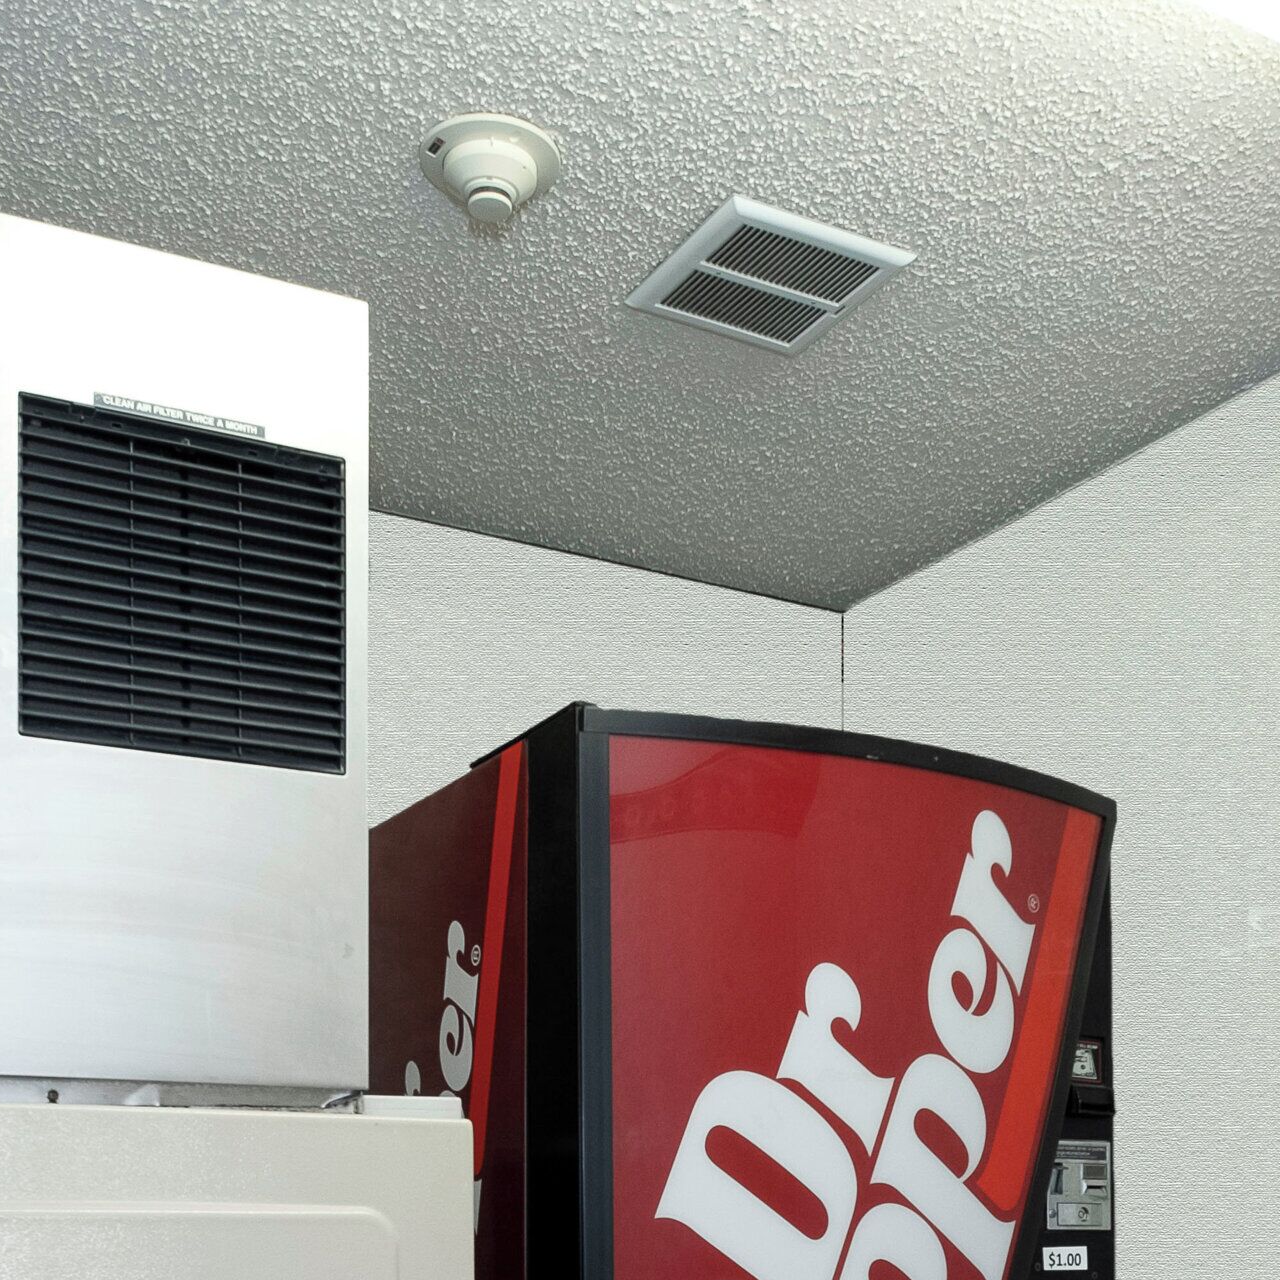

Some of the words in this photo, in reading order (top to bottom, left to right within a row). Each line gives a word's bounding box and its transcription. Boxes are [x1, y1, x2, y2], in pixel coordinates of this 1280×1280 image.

[103, 395, 135, 410] CLEAN
[136, 402, 152, 413] AIR
[153, 405, 183, 420] FILTER
[185, 411, 215, 427] TWICE
[217, 418, 224, 428] A
[226, 420, 258, 435] MONTH
[1048, 1252, 1082, 1268] $1.00
